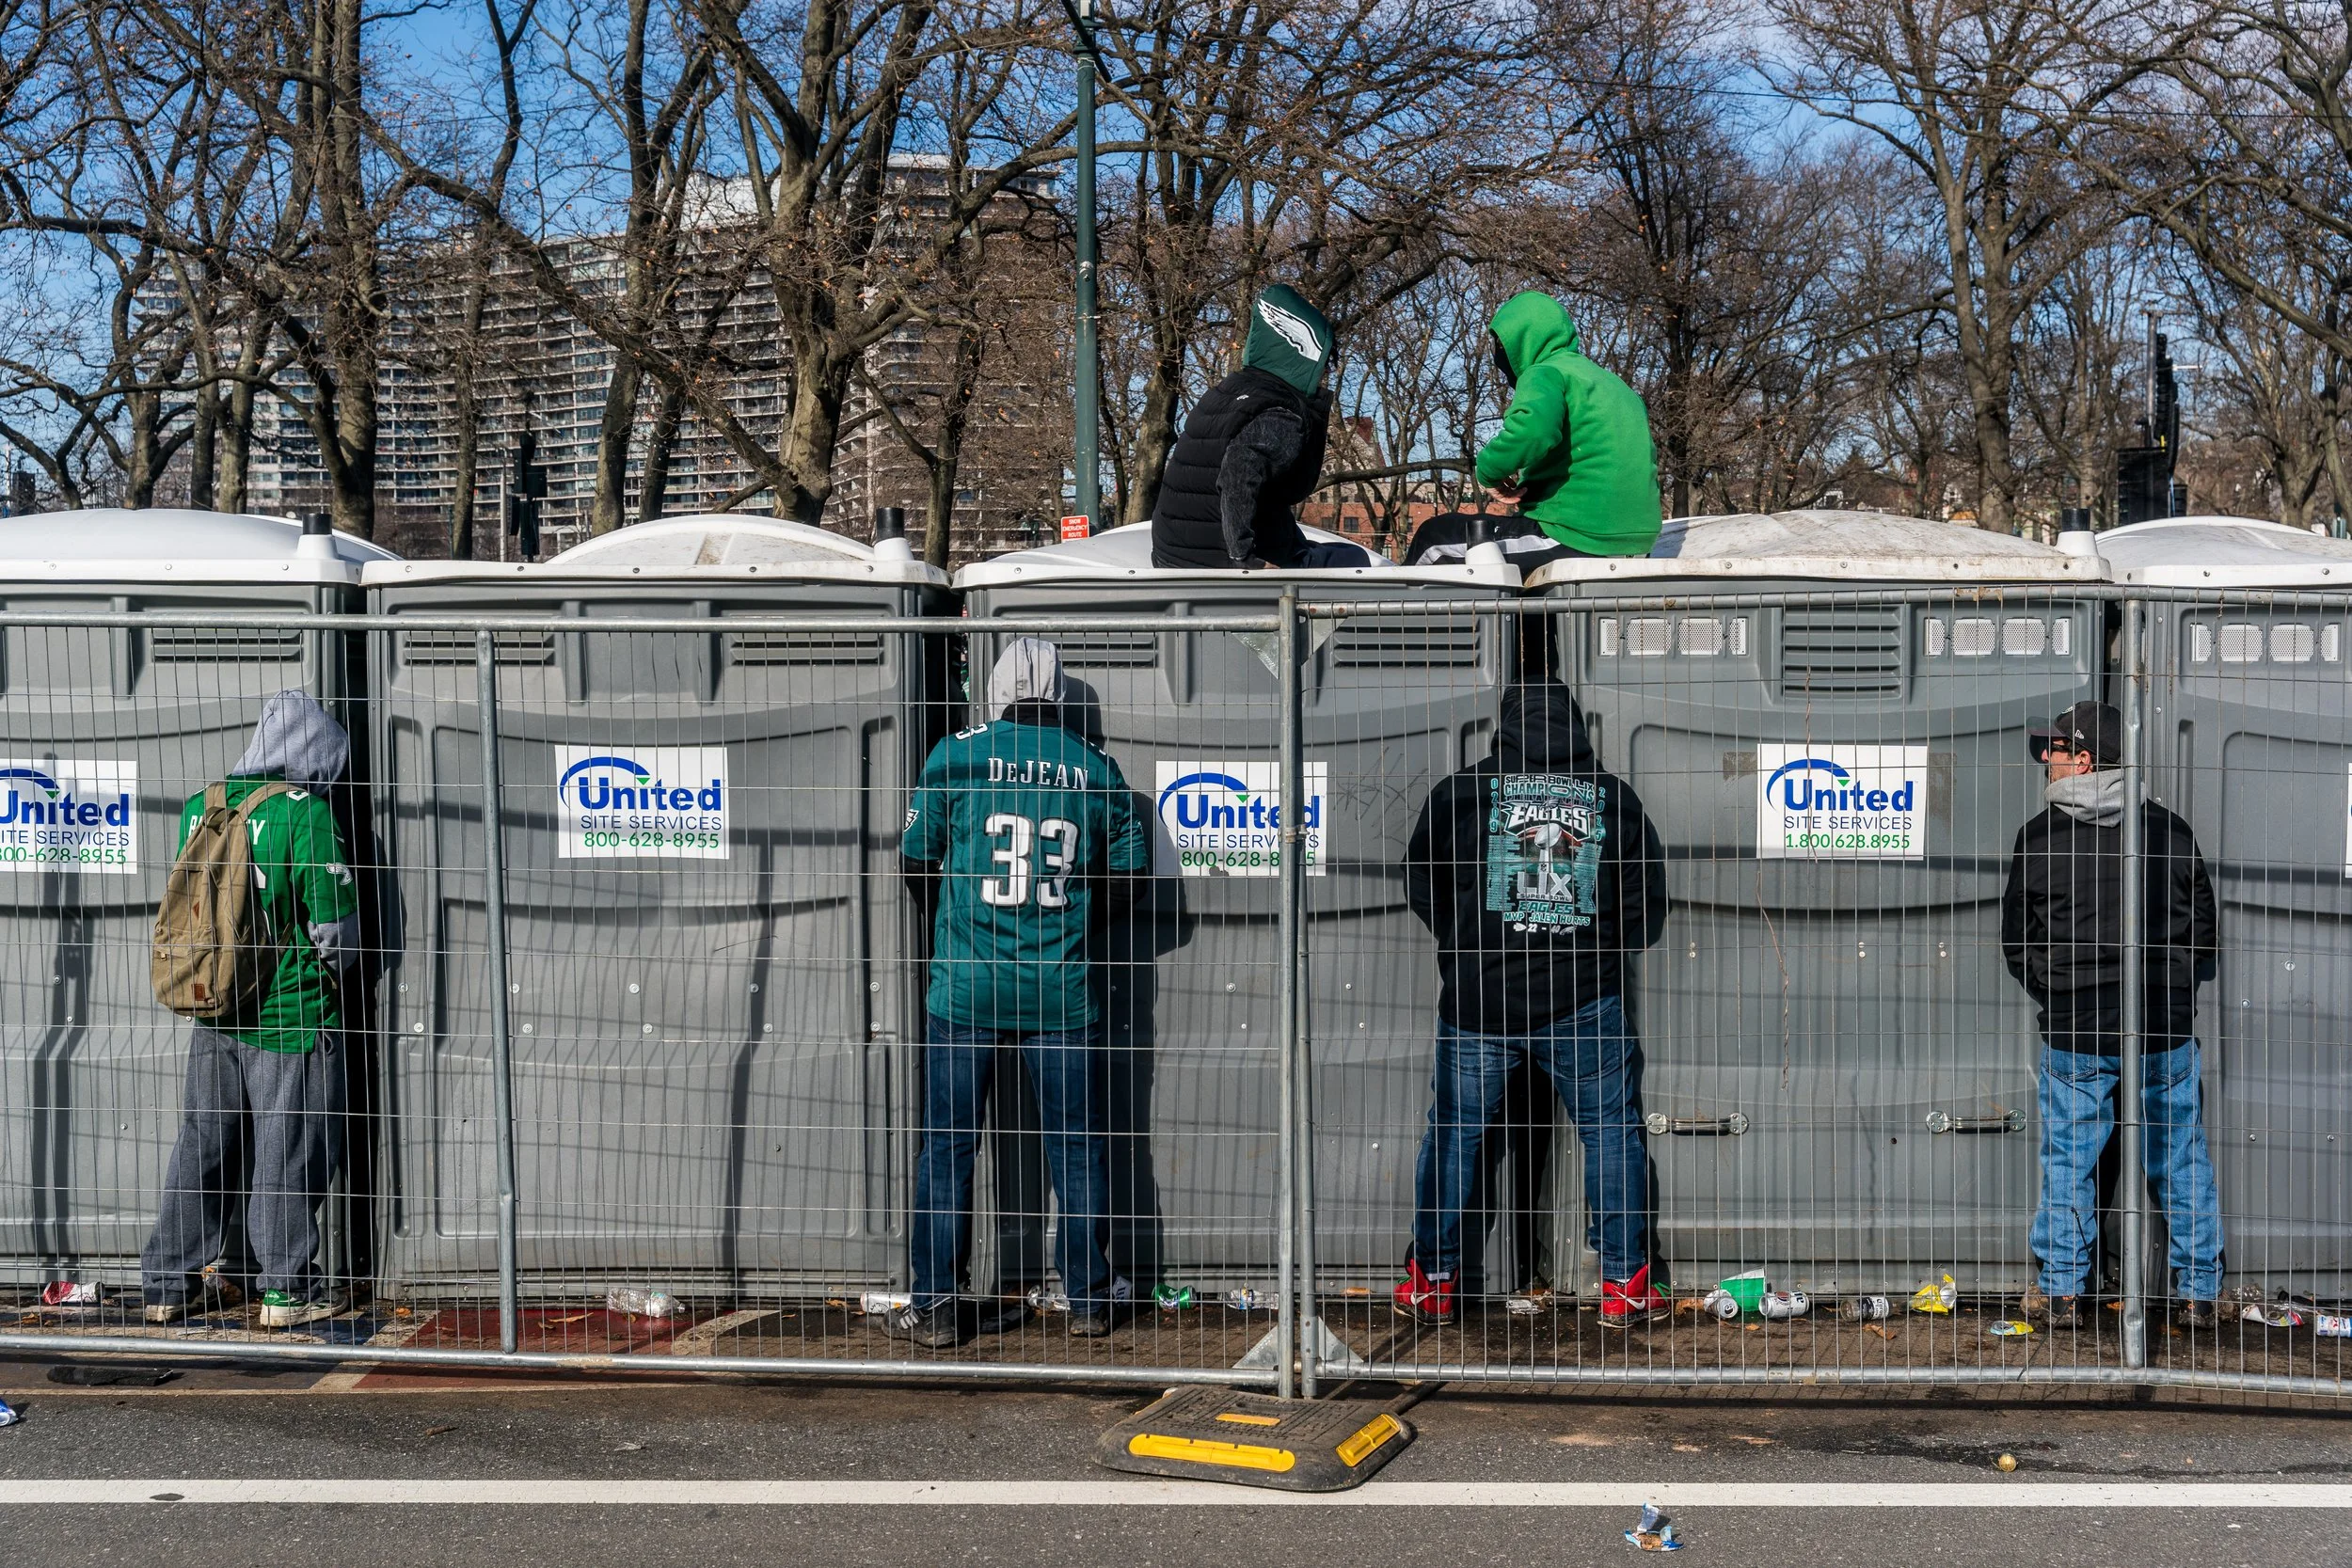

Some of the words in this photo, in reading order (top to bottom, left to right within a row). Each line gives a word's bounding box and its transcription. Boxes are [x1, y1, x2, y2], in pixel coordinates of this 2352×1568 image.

[1505, 774, 1547, 784] SUPER
[1549, 775, 1572, 785] BOWL
[1576, 780, 1595, 791] LIX
[578, 777, 722, 811] United
[1504, 783, 1596, 803] CHAMPIONS
[1785, 779, 1914, 812] United
[1505, 794, 1594, 809] PHILAPHIA
[580, 815, 622, 829] SITE
[628, 815, 722, 831] SERVICES
[1508, 802, 1590, 837] EAGLES
[1785, 816, 1822, 830] SITE
[1829, 816, 1912, 830] SERVICES
[1, 830, 28, 844] ITE
[37, 831, 129, 846] SERVICES
[584, 832, 719, 848] 800-628-8955
[1178, 834, 1219, 848] SITE
[1226, 834, 1319, 848] SERVS
[1786, 833, 1910, 849] 1.800.628.8955
[0, 847, 127, 864] 00-628-8955
[980, 812, 1081, 910] 33
[1181, 851, 1315, 867] 800-628-85
[1518, 901, 1574, 914] EAGLES
[1503, 911, 1525, 922] MVP
[1529, 912, 1558, 924] JALEN
[1559, 915, 1591, 927] HURTS
